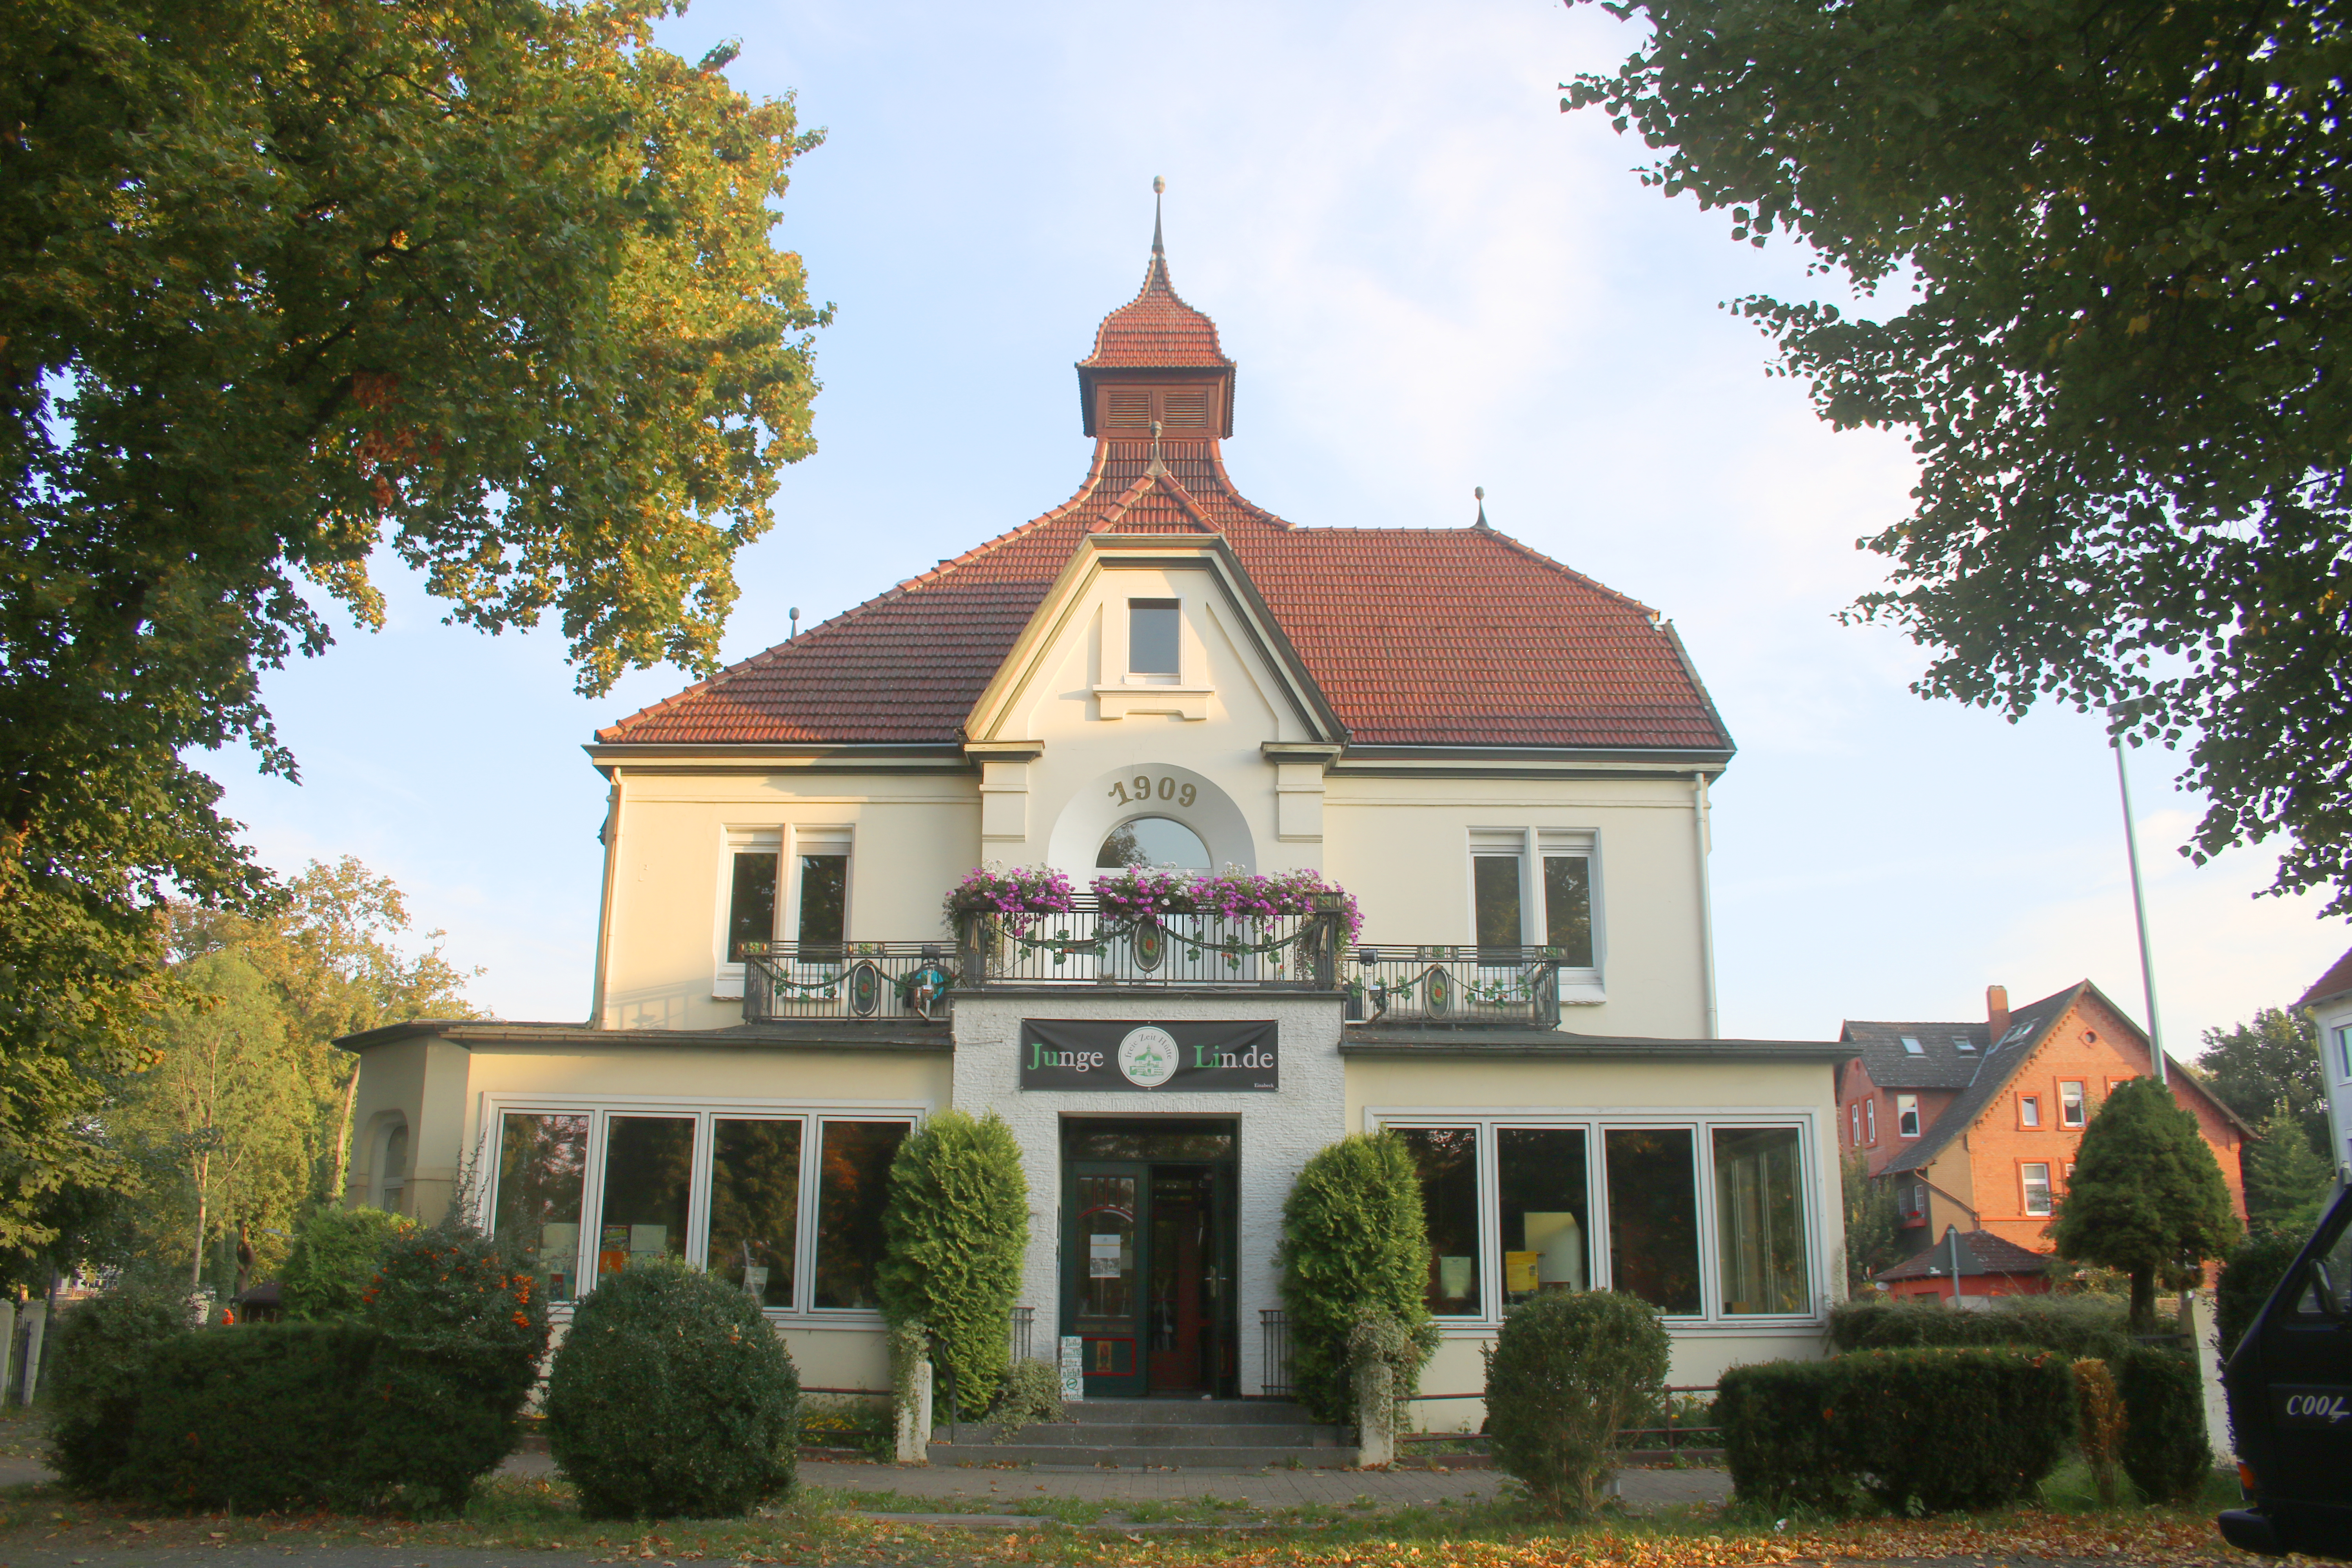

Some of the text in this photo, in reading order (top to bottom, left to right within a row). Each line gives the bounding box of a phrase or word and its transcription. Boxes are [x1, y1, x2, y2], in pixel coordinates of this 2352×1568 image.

[1108, 775, 1197, 807] 1909
[1027, 1044, 1274, 1072] Junge Lin.de
[1125, 1033, 1172, 1059] freie Zeit Hütte
[1063, 1368, 1080, 1376] nicht
[2287, 1395, 2350, 1416] COOL
